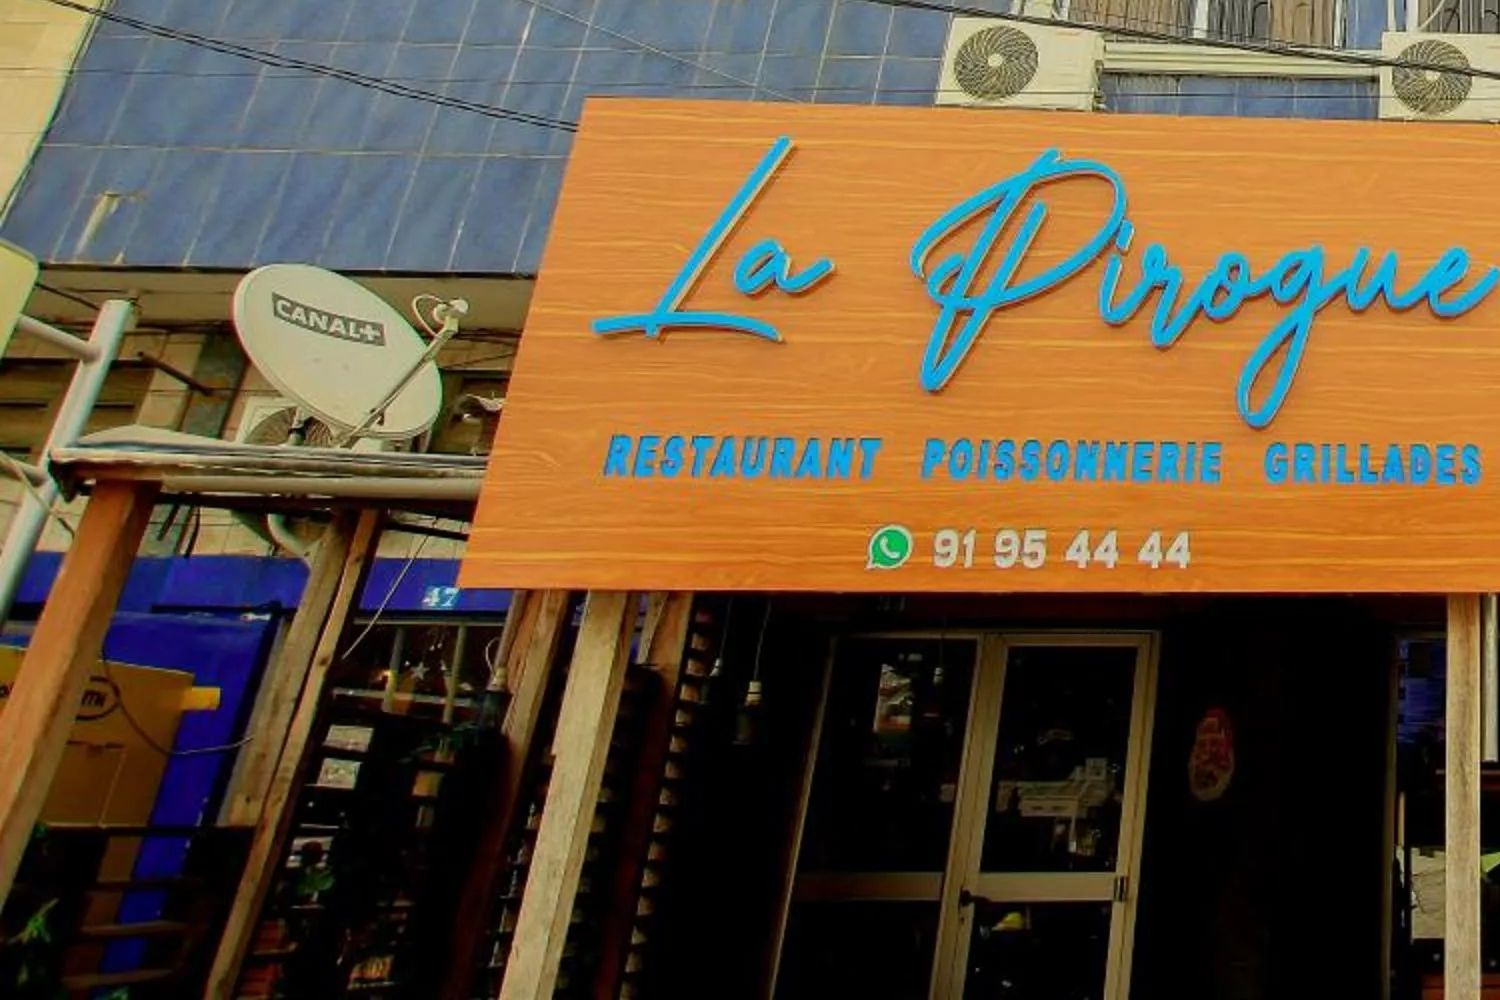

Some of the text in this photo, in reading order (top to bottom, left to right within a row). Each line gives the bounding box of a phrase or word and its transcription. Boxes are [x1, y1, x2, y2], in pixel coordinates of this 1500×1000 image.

[592, 135, 836, 344] La
[275, 298, 382, 342] CANAL+
[602, 433, 1483, 486] RESTAURANT POISSONNERIE GRILLADES
[933, 528, 1191, 568] 91 95 44 44
[422, 585, 460, 608] 47
